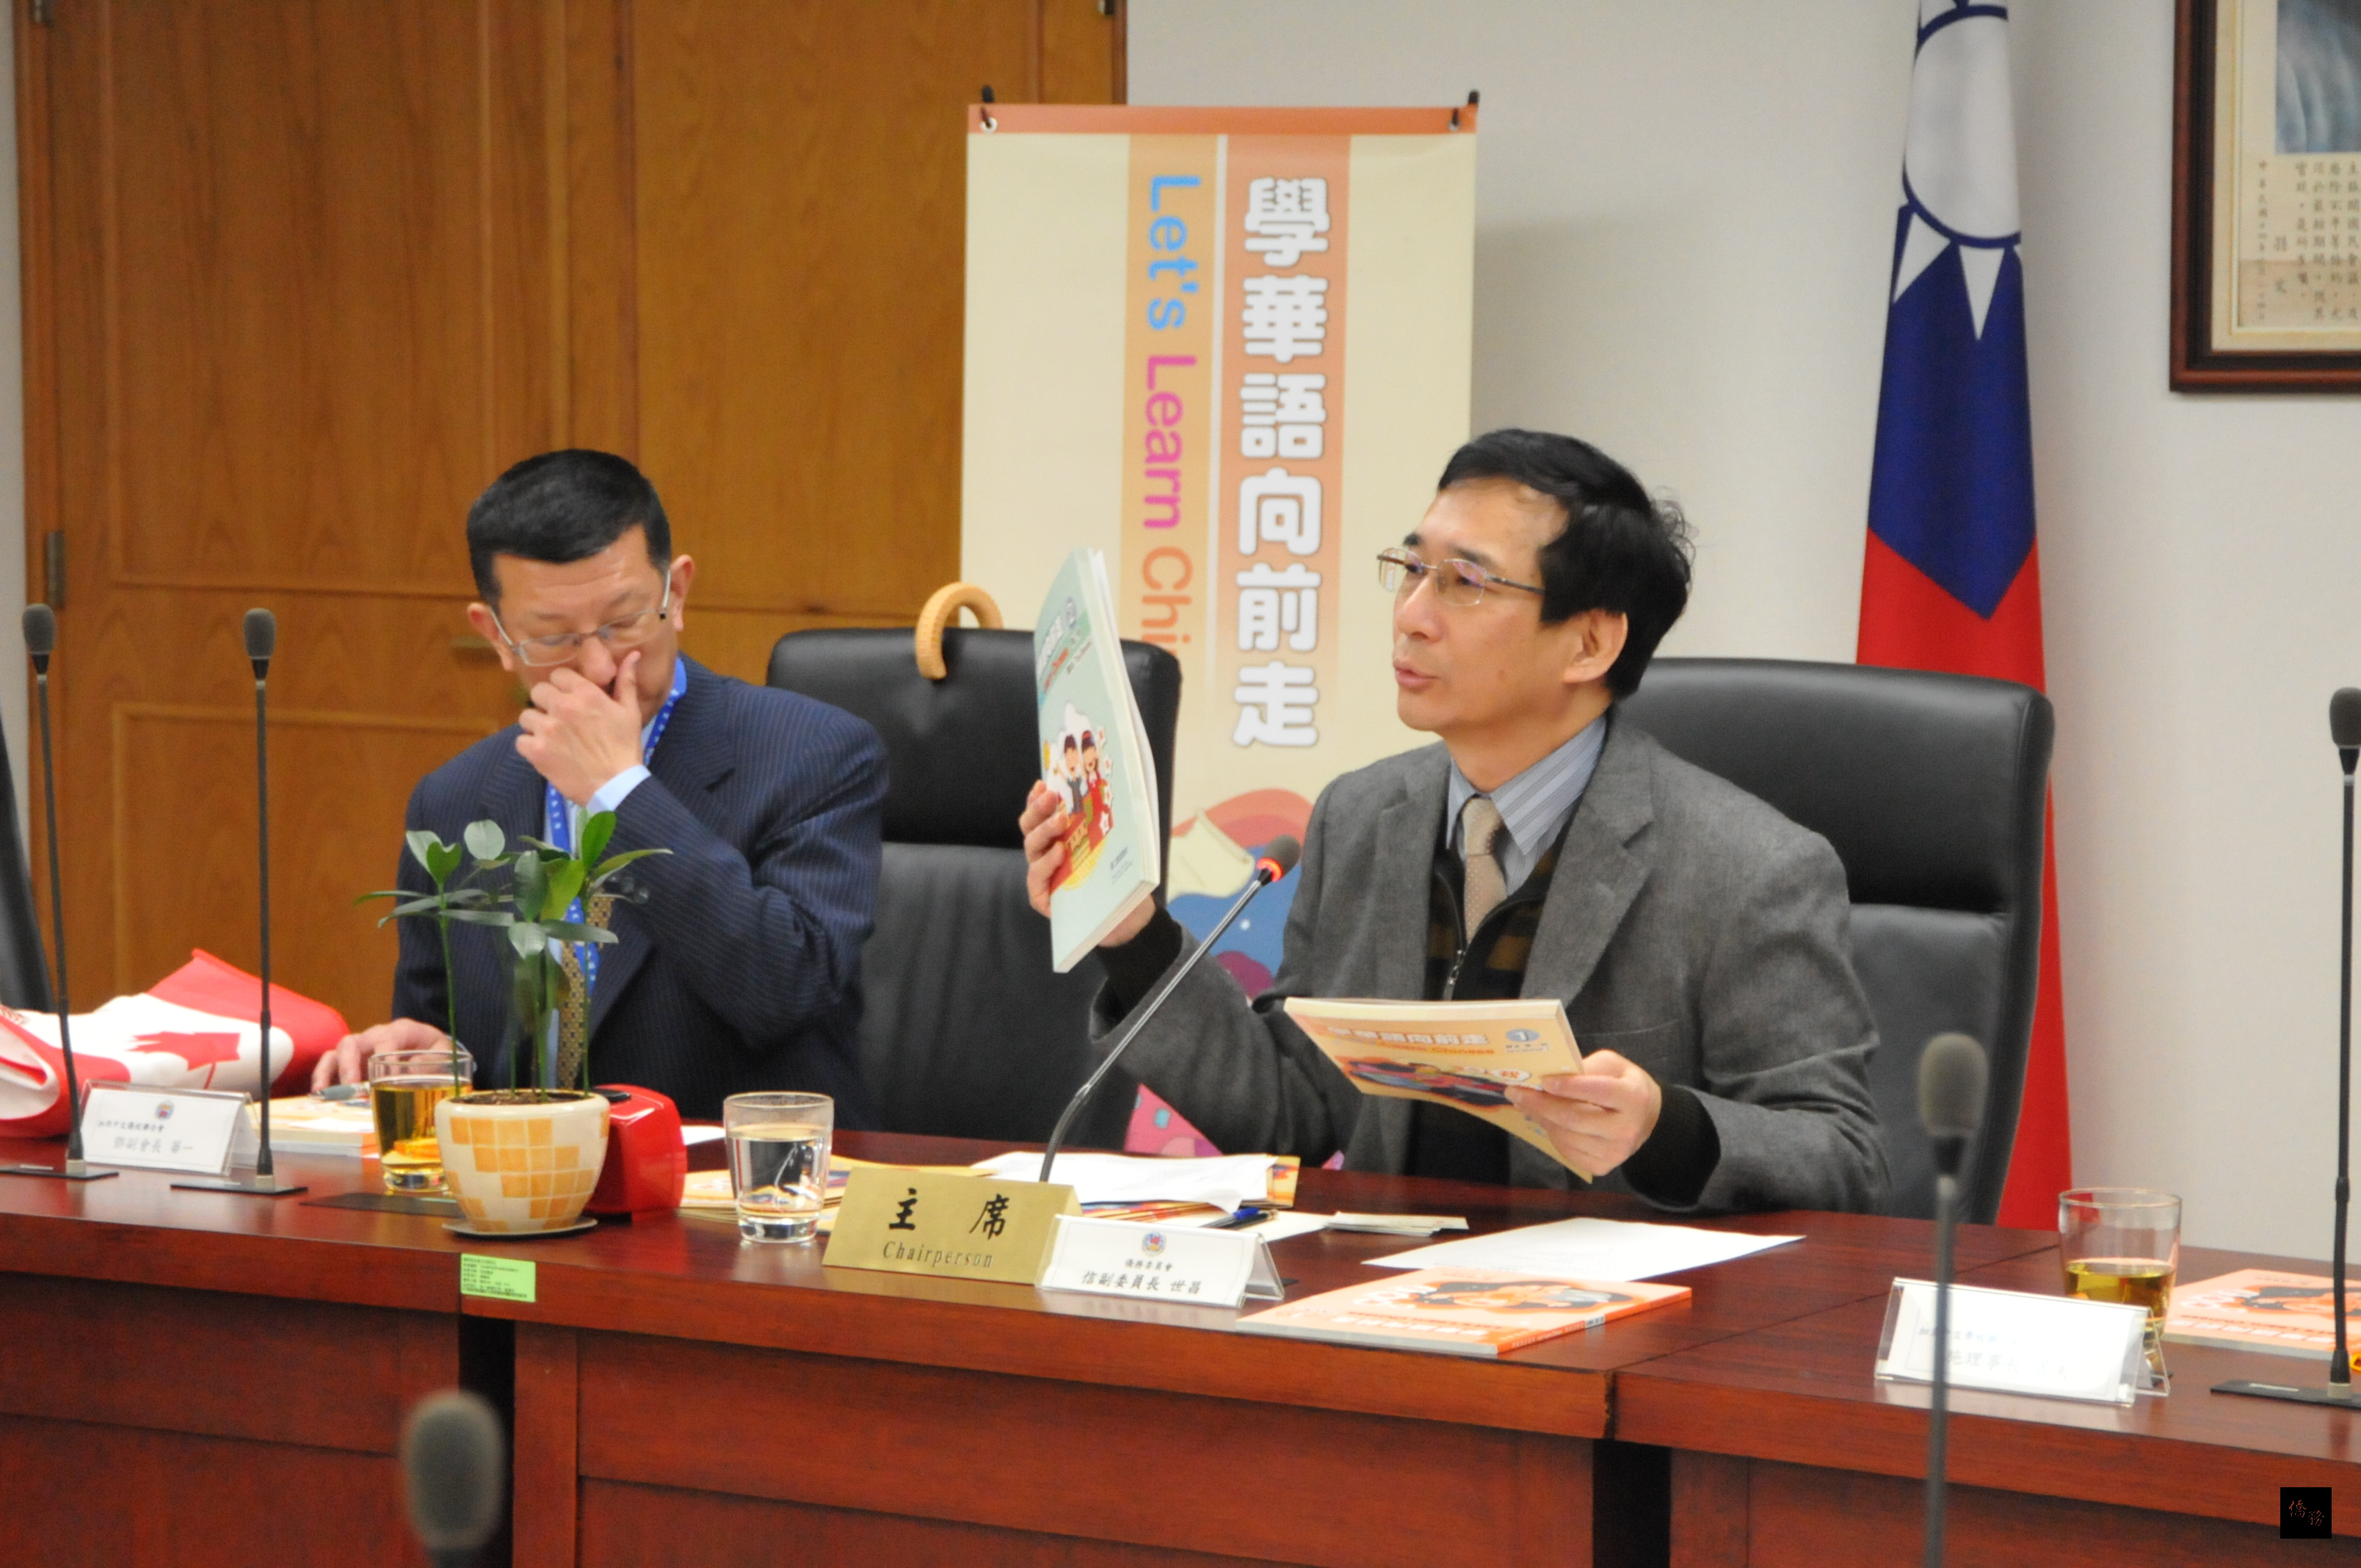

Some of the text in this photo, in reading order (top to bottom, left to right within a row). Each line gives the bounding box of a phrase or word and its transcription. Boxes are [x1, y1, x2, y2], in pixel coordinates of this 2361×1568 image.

[1142, 175, 1202, 656] Let's Learn Chi
[1232, 176, 1331, 747] 學華語向前走
[888, 1187, 1010, 1241] 主席
[882, 1241, 993, 1268] Chairperson
[1081, 1271, 1202, 1295] 信副委員長 世昌
